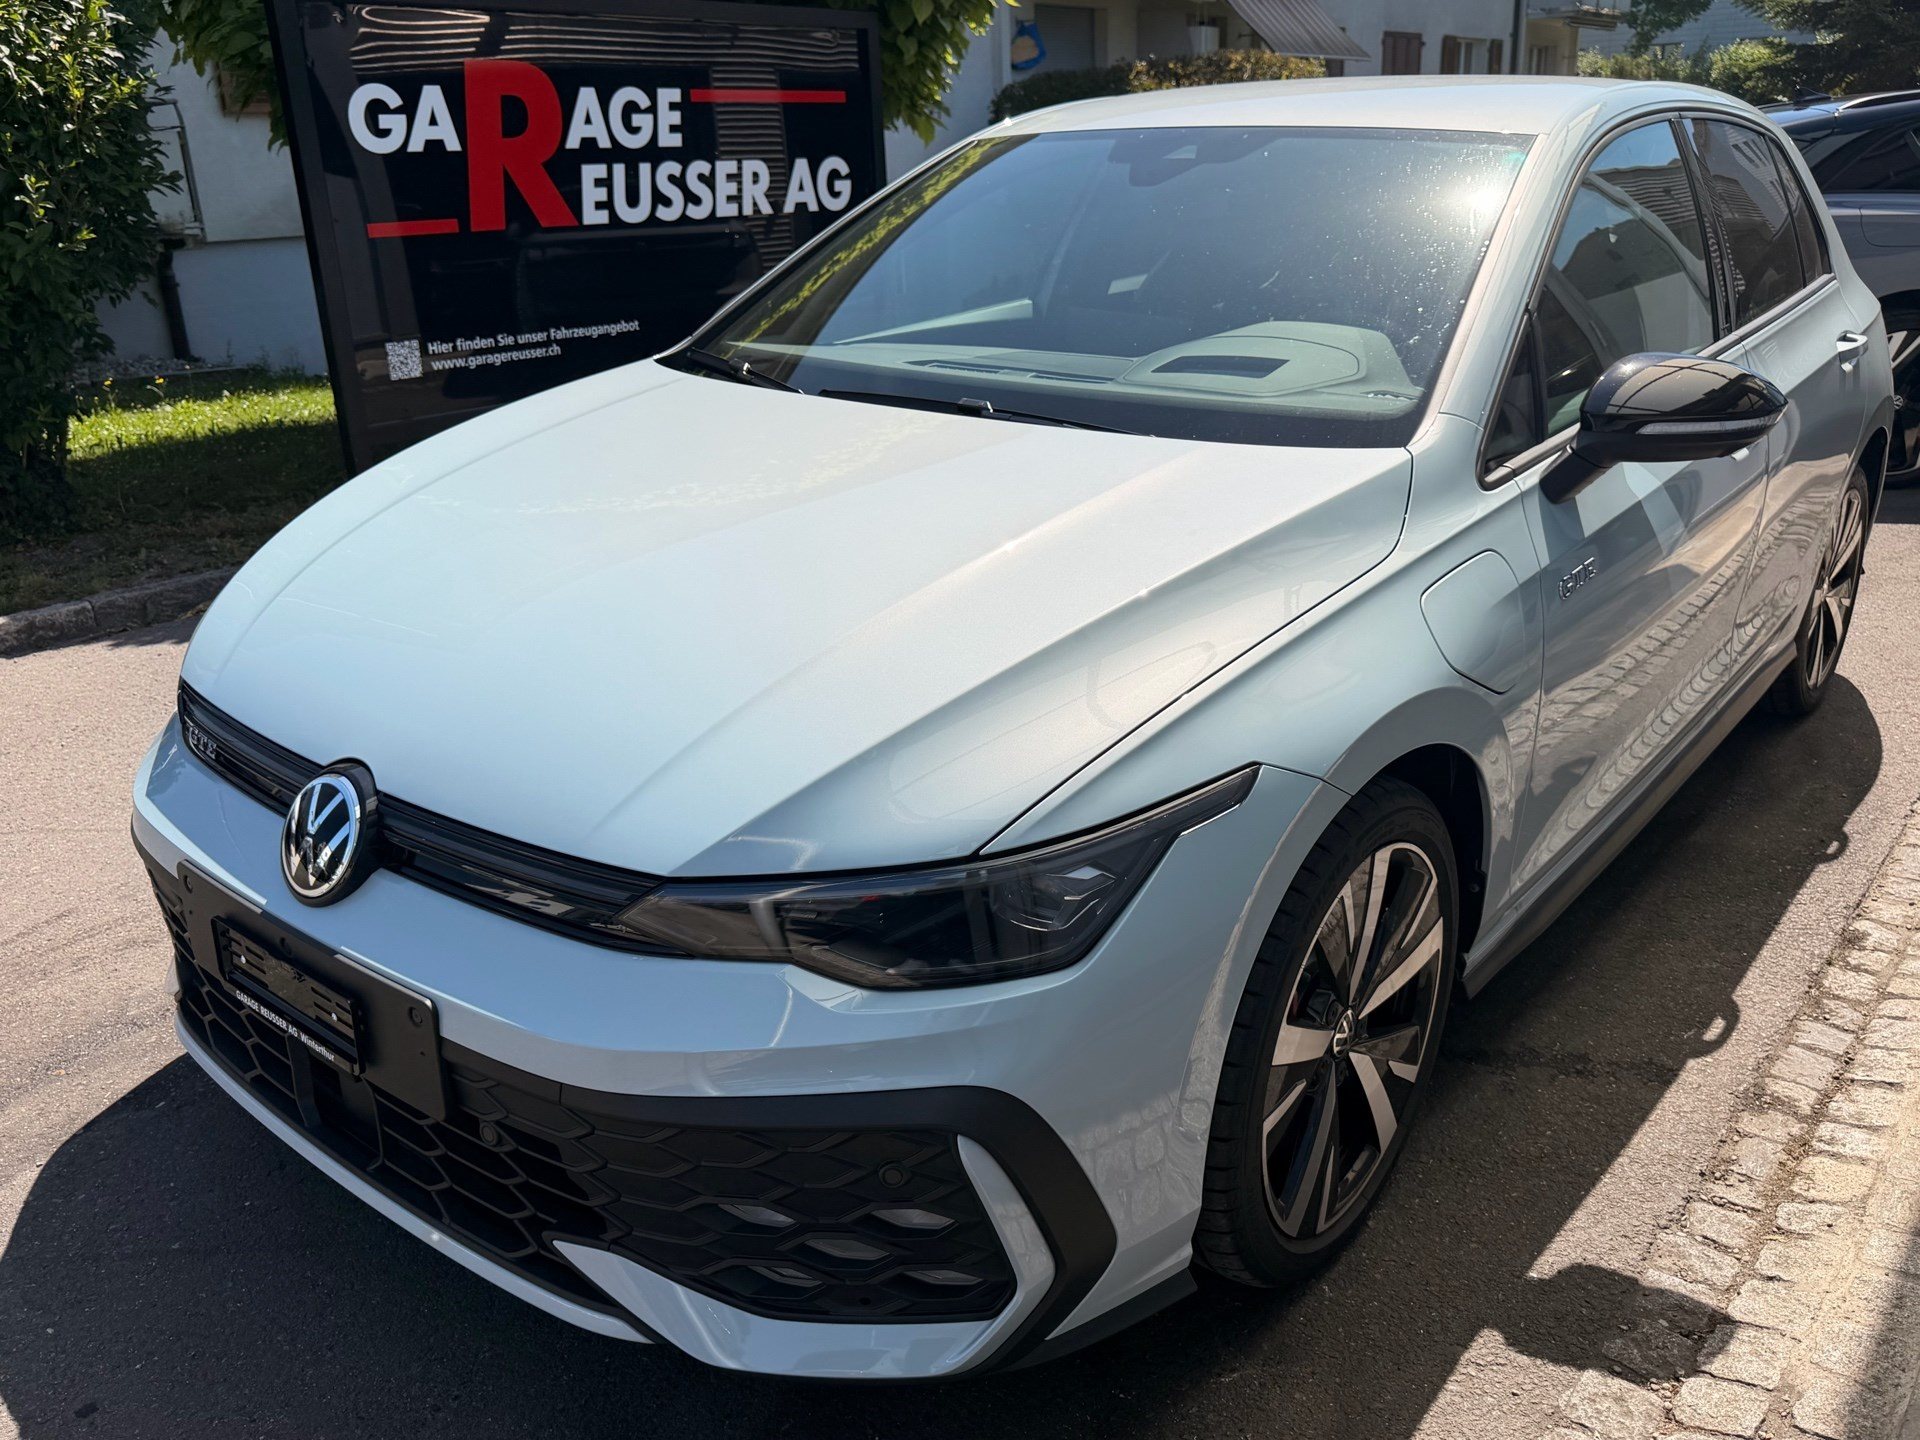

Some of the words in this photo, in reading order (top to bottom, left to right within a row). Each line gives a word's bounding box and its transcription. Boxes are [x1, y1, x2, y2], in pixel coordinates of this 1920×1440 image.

[348, 58, 683, 232] GARAGE
[783, 155, 853, 213] AG
[427, 340, 454, 355] Hier
[456, 336, 496, 351] finden
[496, 333, 515, 347] Sie
[516, 331, 548, 345] unser
[549, 320, 640, 340] Fahrzeugangebot
[431, 343, 562, 370] www.garagereusser.ch
[1558, 556, 1597, 600] GTE
[189, 726, 218, 760] GTE
[235, 990, 260, 1012] GARAGE
[260, 1005, 288, 1031] REUSSER
[288, 1024, 298, 1038] AG
[300, 1032, 335, 1062] Winterthur
